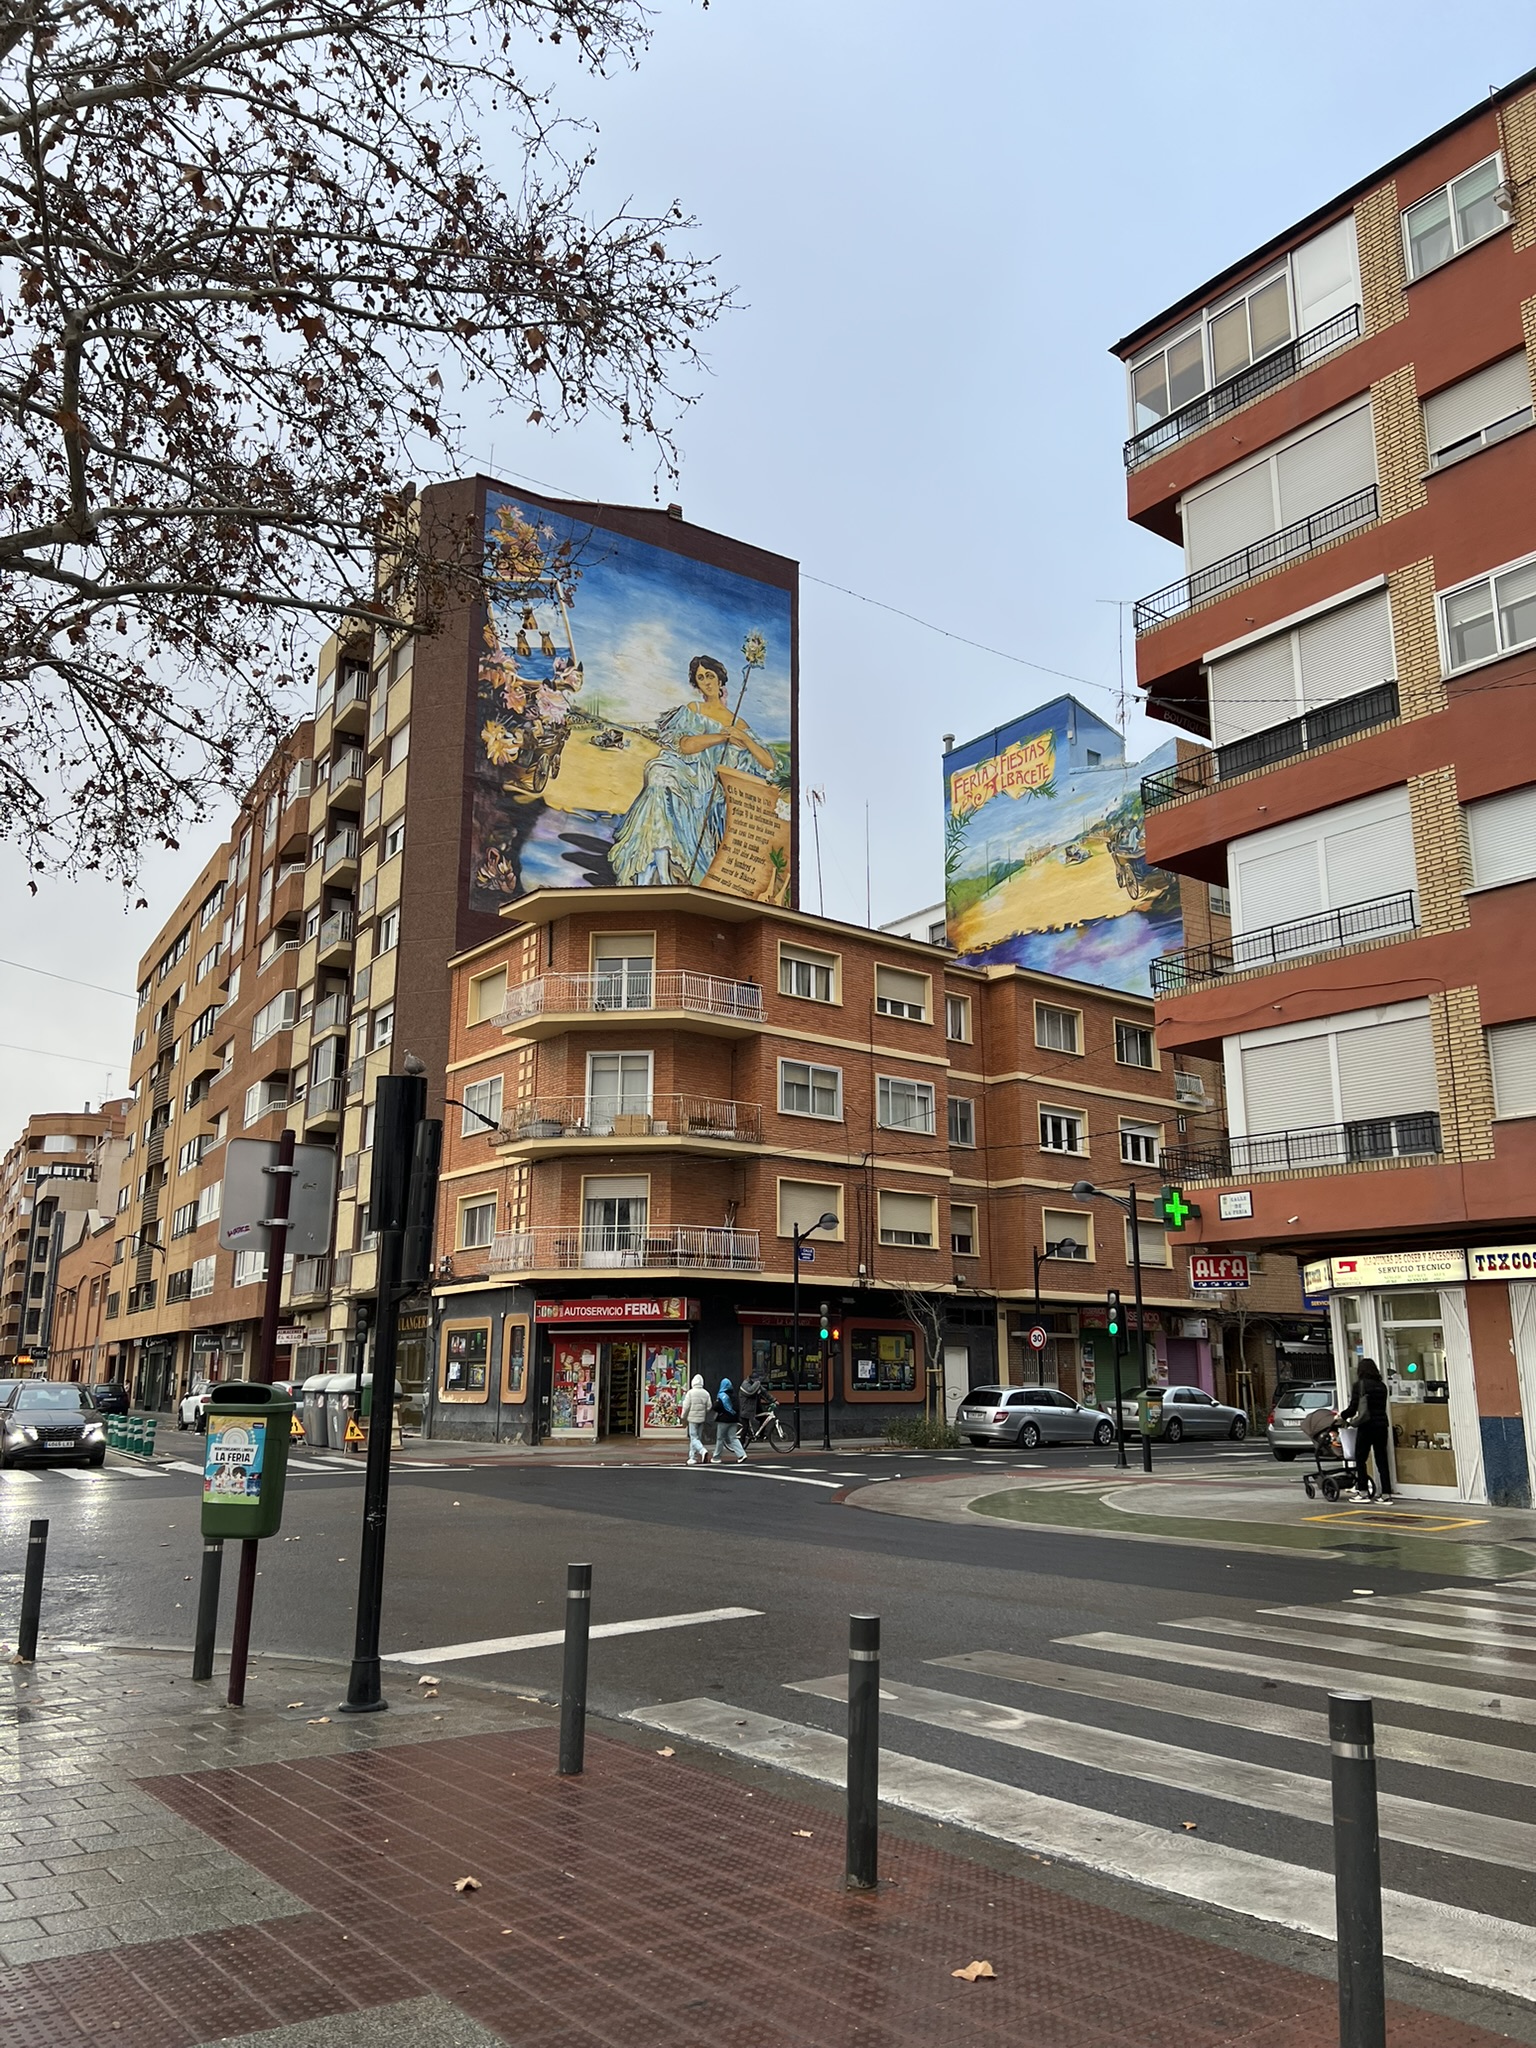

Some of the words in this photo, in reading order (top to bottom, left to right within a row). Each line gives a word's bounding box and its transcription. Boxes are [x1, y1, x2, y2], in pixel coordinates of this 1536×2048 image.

[1164, 710, 1208, 735] BOUTIQUE
[954, 766, 988, 804] FERIA
[989, 762, 998, 773] Y
[1000, 740, 1046, 774] FIESTAS
[974, 763, 1051, 807] ALBACETE
[1394, 1254, 1402, 1264] DE
[1403, 1253, 1421, 1263] COSER
[1422, 1252, 1426, 1262] Y
[1428, 1250, 1464, 1262] ACCESORIOS
[1196, 1258, 1246, 1278] ALFA
[1378, 1265, 1414, 1274] SERVICIO
[1416, 1262, 1452, 1272] TECNICO
[564, 1306, 622, 1316] AUTOSERVICIO
[624, 1302, 660, 1316] FERIA
[1032, 1334, 1042, 1342] 30
[216, 1452, 226, 1461] LA
[228, 1453, 250, 1462] FERIA
